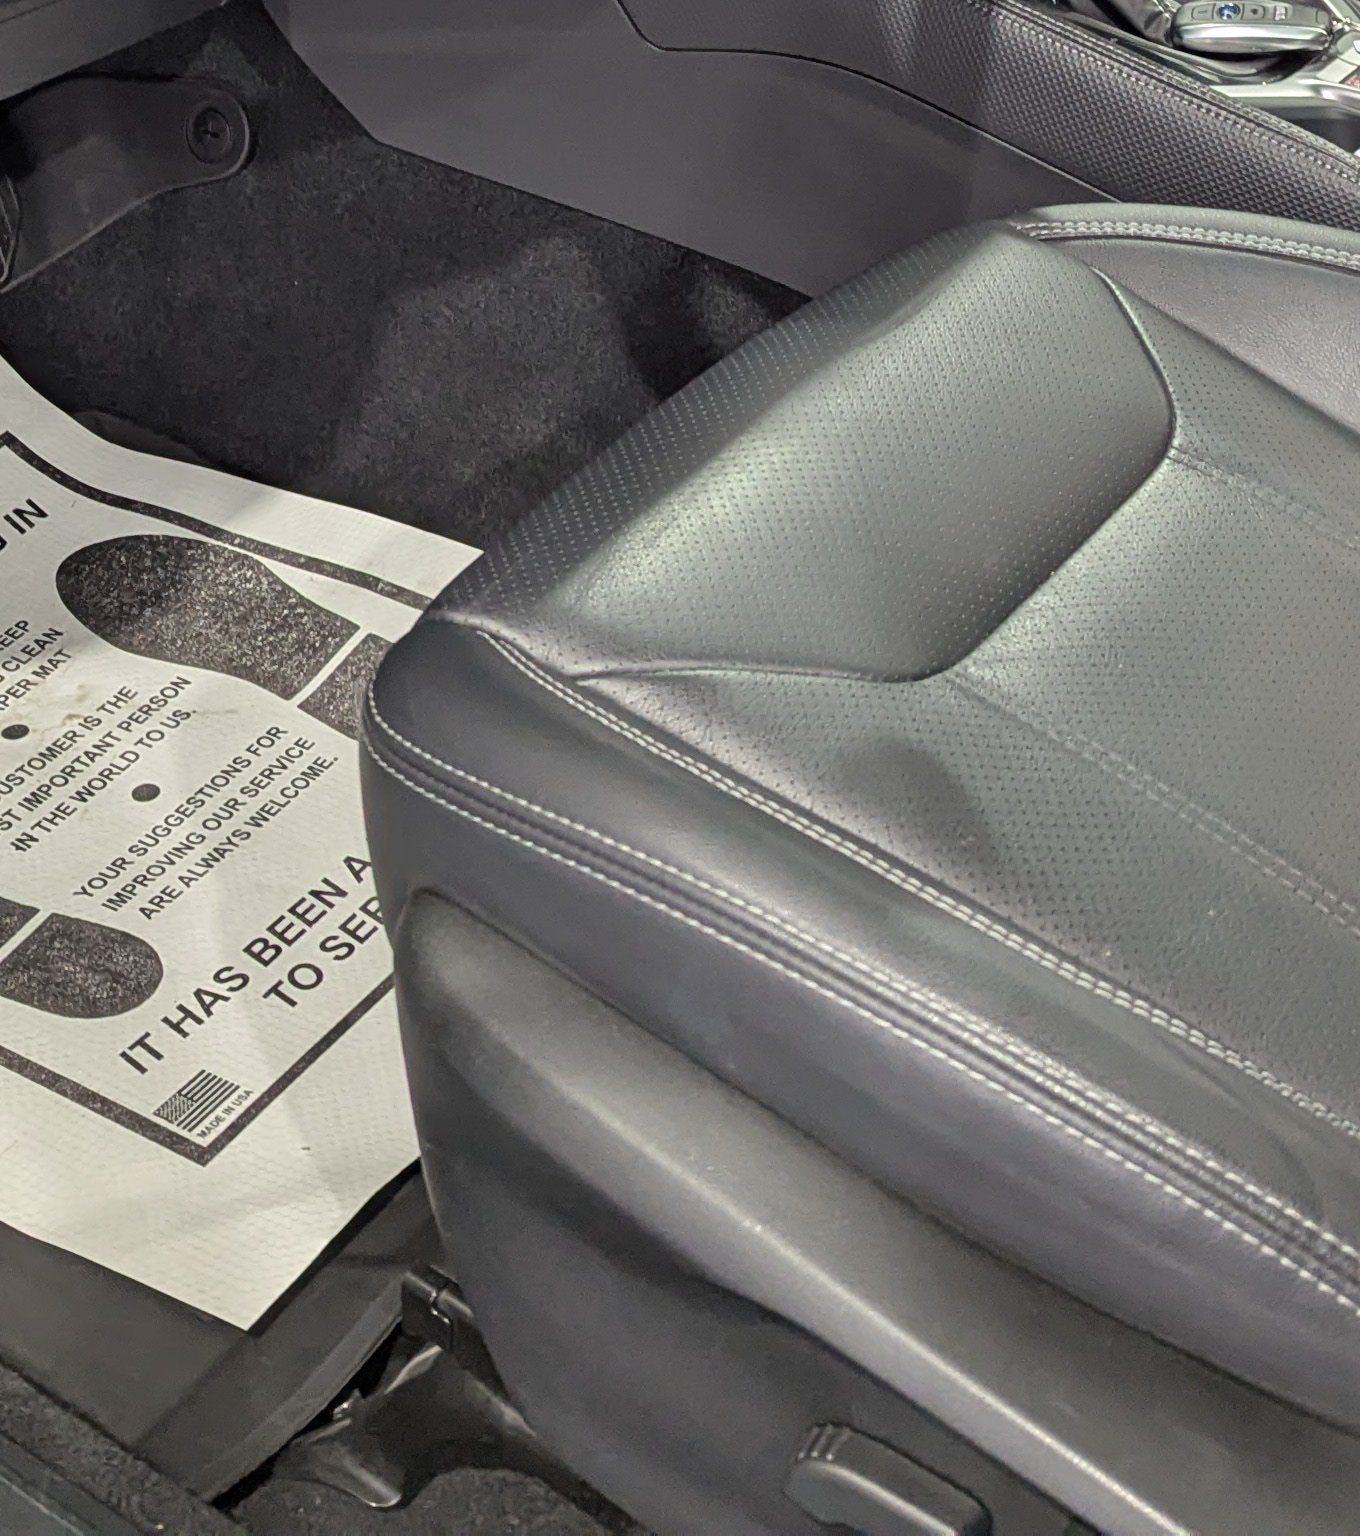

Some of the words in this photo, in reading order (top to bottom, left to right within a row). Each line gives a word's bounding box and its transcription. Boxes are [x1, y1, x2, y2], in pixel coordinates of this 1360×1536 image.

[3, 498, 49, 535] IN
[1, 627, 64, 672] CLEAN
[32, 649, 73, 680] MAT
[78, 715, 103, 731] IS
[96, 685, 139, 716] THE
[10, 832, 40, 853] IN
[30, 802, 78, 833] THE
[69, 750, 140, 804] WORLD
[133, 729, 165, 749] TO
[160, 709, 197, 730] US.
[17, 730, 122, 812] IMPORTANT
[117, 675, 192, 733] PERSON
[72, 856, 135, 900] YOUR
[127, 755, 253, 857] SUGGESTIONS
[246, 725, 289, 757] FOR
[101, 831, 206, 912] IMPROVING
[201, 797, 248, 832] OUR
[239, 736, 316, 798] SERVICE
[138, 885, 184, 920] ARE
[177, 828, 252, 889] ALWAYS
[243, 755, 339, 829] WELCOME.
[119, 1031, 165, 1075] IT
[160, 966, 250, 1039] HAS
[242, 877, 348, 967] BEEN
[343, 854, 372, 884] A
[262, 963, 324, 1008] TO
[319, 896, 385, 961] SER
[197, 1115, 226, 1139] MADE
[222, 1105, 236, 1116] IN
[231, 1090, 254, 1106] USA
